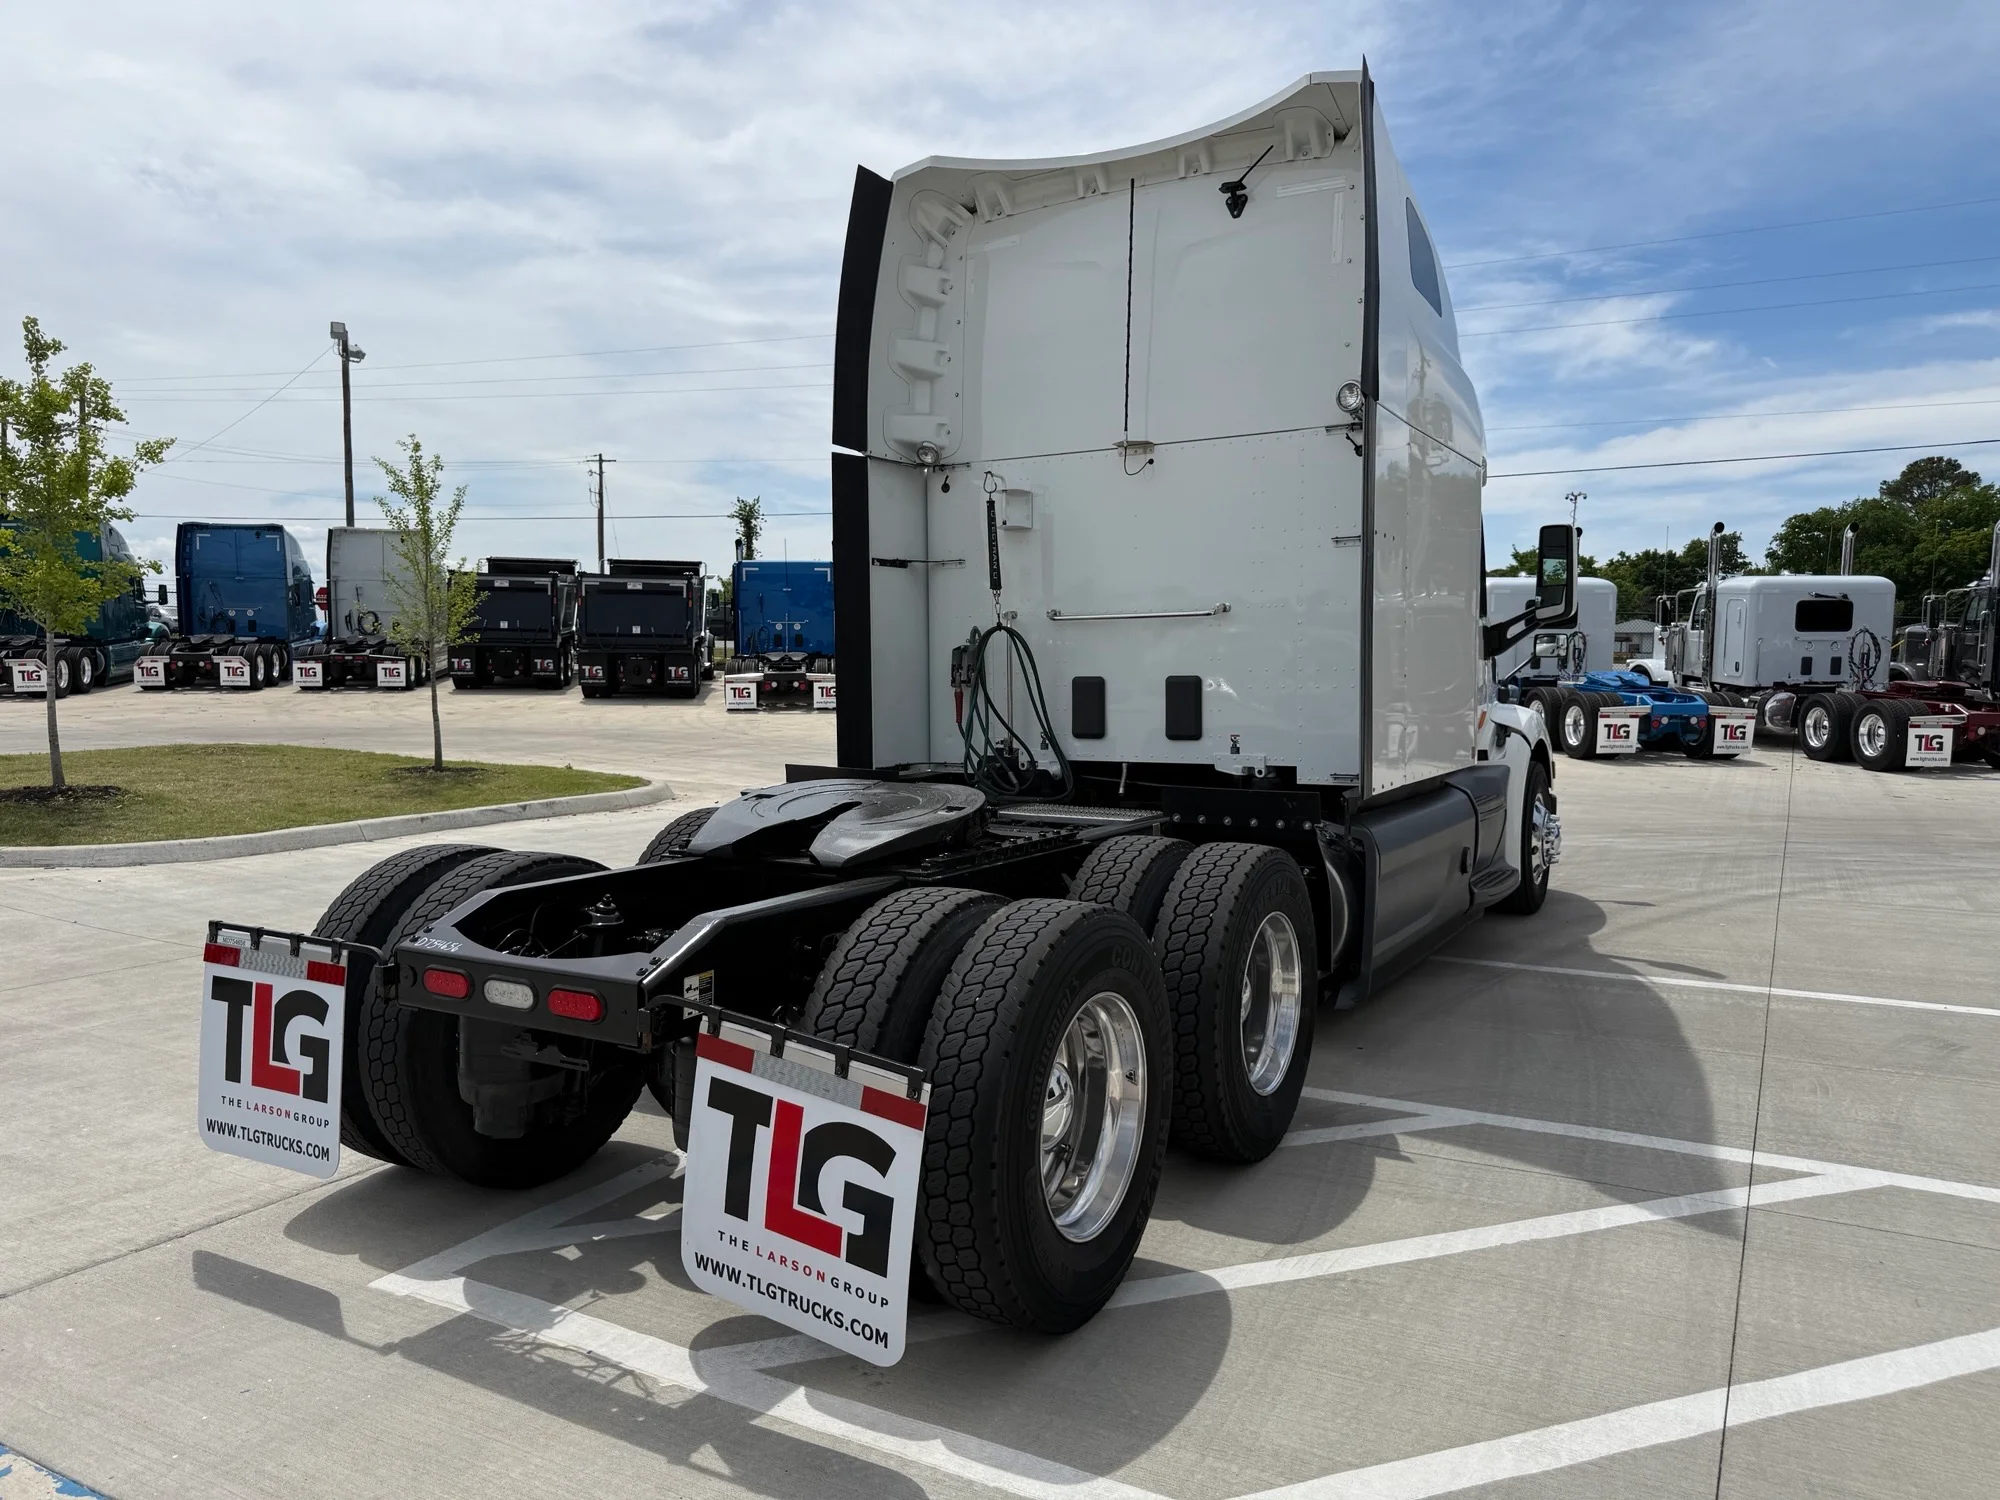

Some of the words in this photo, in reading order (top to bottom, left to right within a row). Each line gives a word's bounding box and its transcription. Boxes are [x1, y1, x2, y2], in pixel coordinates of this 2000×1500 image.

[451, 658, 471, 669] TLG
[534, 659, 554, 670] TLG
[18, 670, 41, 681] TLG
[138, 666, 159, 677] TLG
[224, 666, 244, 677] TLG
[297, 667, 317, 677] TLG
[381, 667, 400, 677] TLG
[582, 665, 603, 677] TLG
[668, 666, 688, 678] TLG
[730, 687, 751, 698] TLG
[1604, 723, 1630, 740] TLG
[1721, 724, 1747, 740] TLG
[1914, 734, 1944, 751] TLG
[414, 937, 463, 952] D754656
[211, 975, 330, 1104] TLG
[221, 1095, 242, 1108] THE
[246, 1101, 291, 1119] LARSON
[293, 1112, 330, 1128] GROUP
[206, 1117, 330, 1162] WWW.TLGTRUCKS.COM
[707, 1076, 897, 1279] TLG
[717, 1230, 749, 1252] THE
[755, 1245, 826, 1283] LARSON
[830, 1276, 889, 1308] GROUP
[694, 1251, 889, 1349] WWW.TLGTRUCKS.COM
